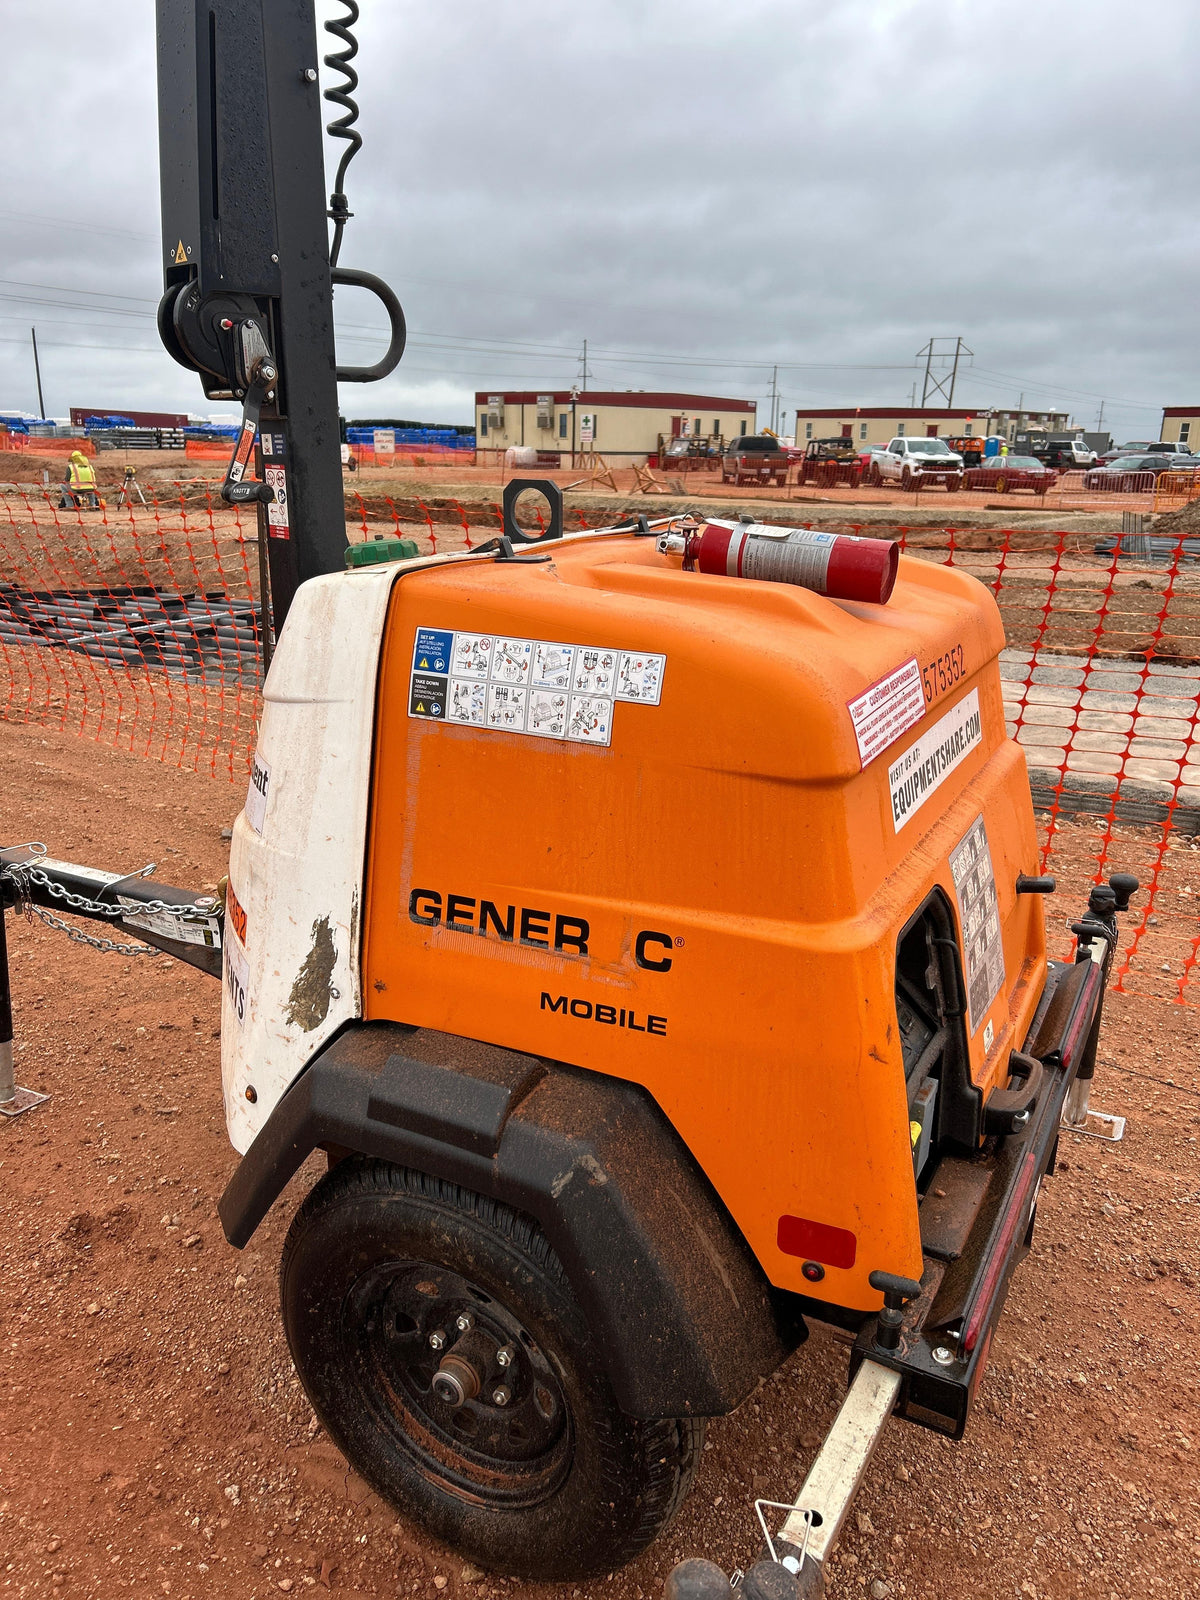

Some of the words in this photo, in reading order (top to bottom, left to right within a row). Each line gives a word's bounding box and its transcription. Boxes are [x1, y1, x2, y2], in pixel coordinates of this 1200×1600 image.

[868, 683, 890, 707] CUSTOMER
[889, 665, 917, 691] RESPONSIBILITY
[922, 644, 966, 703] 575352
[889, 763, 904, 786] VISIT
[905, 754, 912, 773] US
[913, 747, 921, 763] AT:
[892, 710, 981, 822] EQUIPMENTSHARE.COM
[540, 991, 668, 1037] MOBILE
